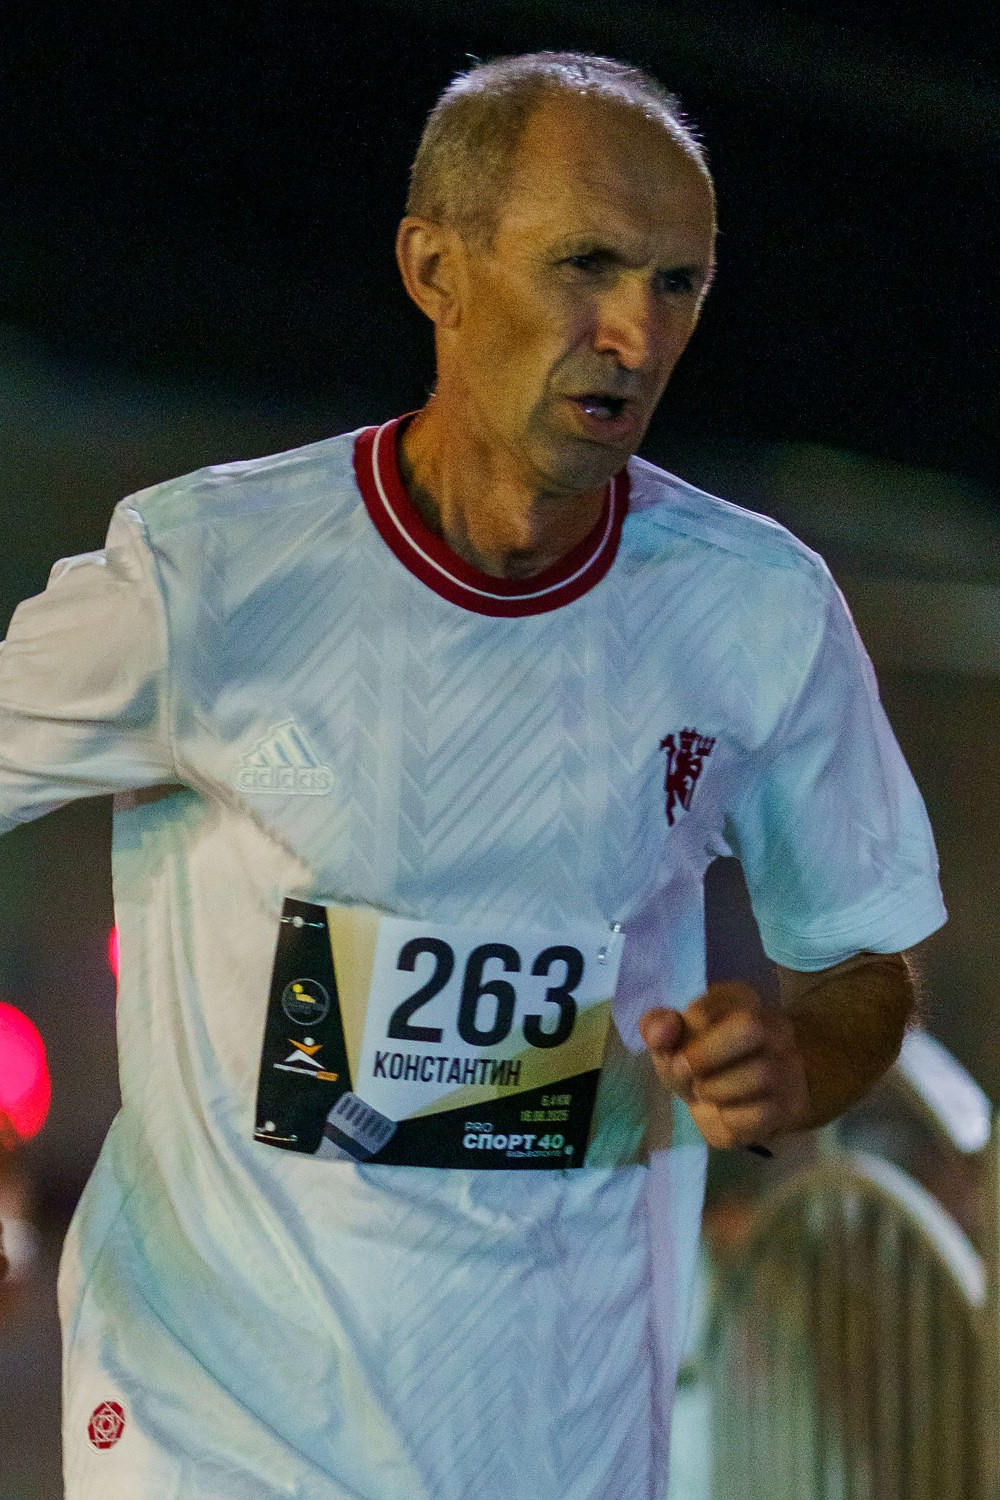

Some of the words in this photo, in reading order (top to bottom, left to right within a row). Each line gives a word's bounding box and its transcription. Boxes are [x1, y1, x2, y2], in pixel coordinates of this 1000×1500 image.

[387, 936, 585, 1049] 263
[373, 1050, 522, 1086] КОНСТАНТИН
[462, 1133, 537, 1150] СПОРТ
[537, 1134, 565, 1150] 40
